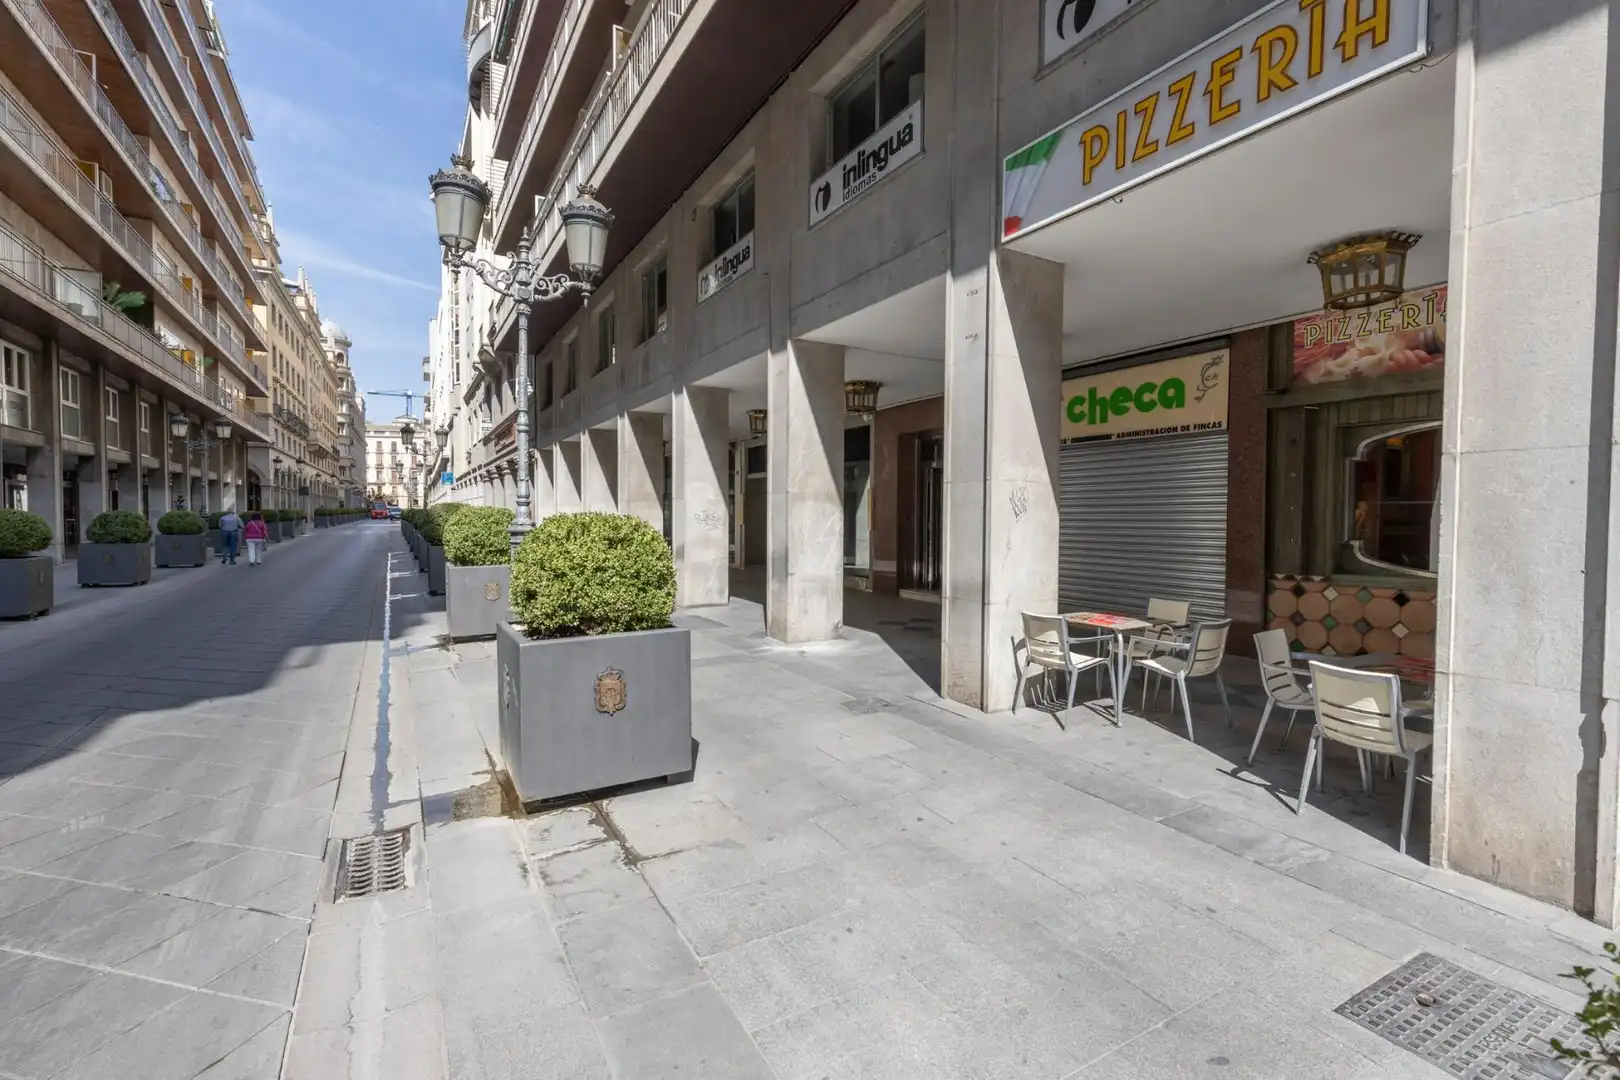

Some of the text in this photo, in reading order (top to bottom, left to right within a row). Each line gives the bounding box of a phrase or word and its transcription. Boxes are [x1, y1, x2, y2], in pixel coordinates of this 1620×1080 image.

[842, 122, 914, 190] inlingua
[843, 171, 877, 202] idiomas
[714, 245, 751, 279] inlingua
[1066, 377, 1186, 425] checa
[1115, 420, 1223, 439] ADMINISTRACION DE FINCAS
